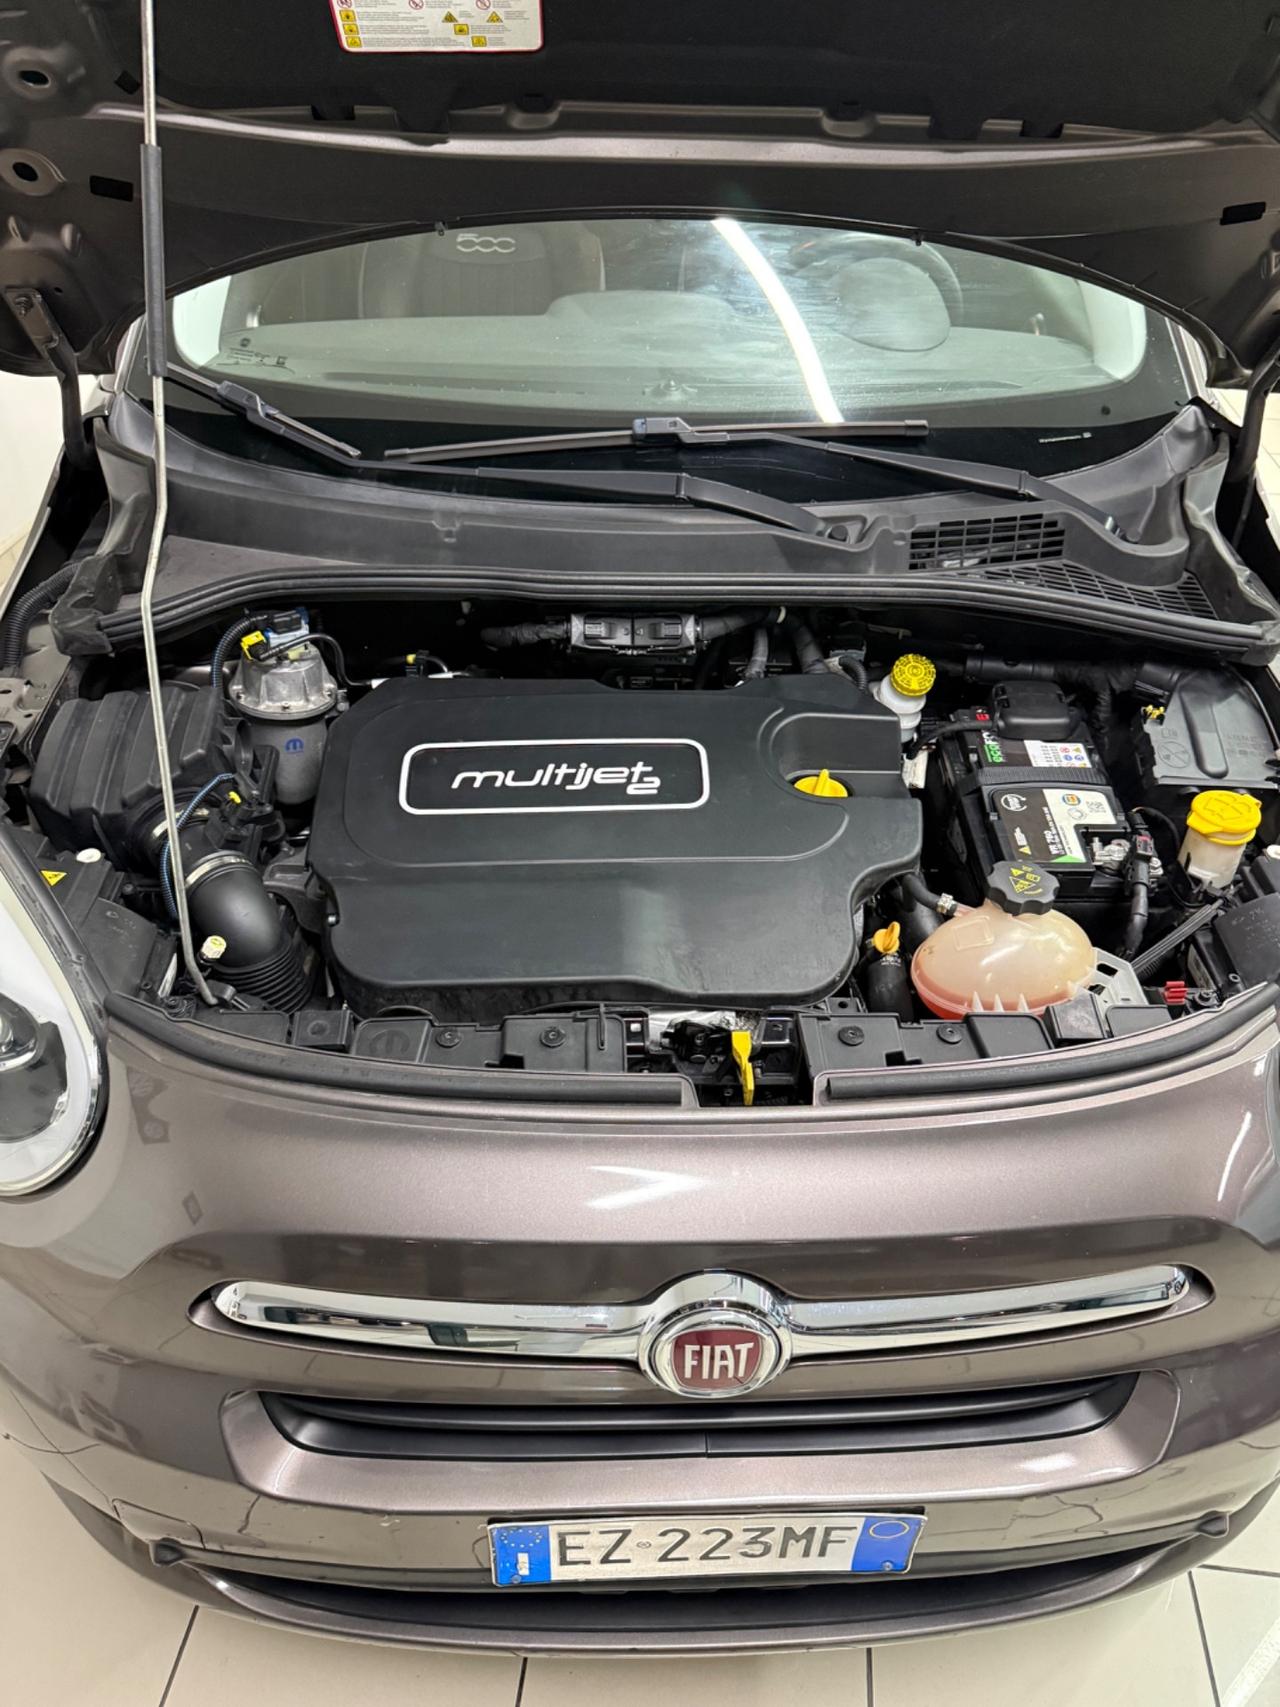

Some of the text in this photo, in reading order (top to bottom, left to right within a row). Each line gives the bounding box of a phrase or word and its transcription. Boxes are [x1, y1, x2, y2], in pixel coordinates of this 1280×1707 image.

[456, 233, 516, 253] 500
[451, 762, 653, 790] multijet
[684, 1342, 755, 1380] FIAT
[557, 1526, 858, 1567] EZ 223MF
